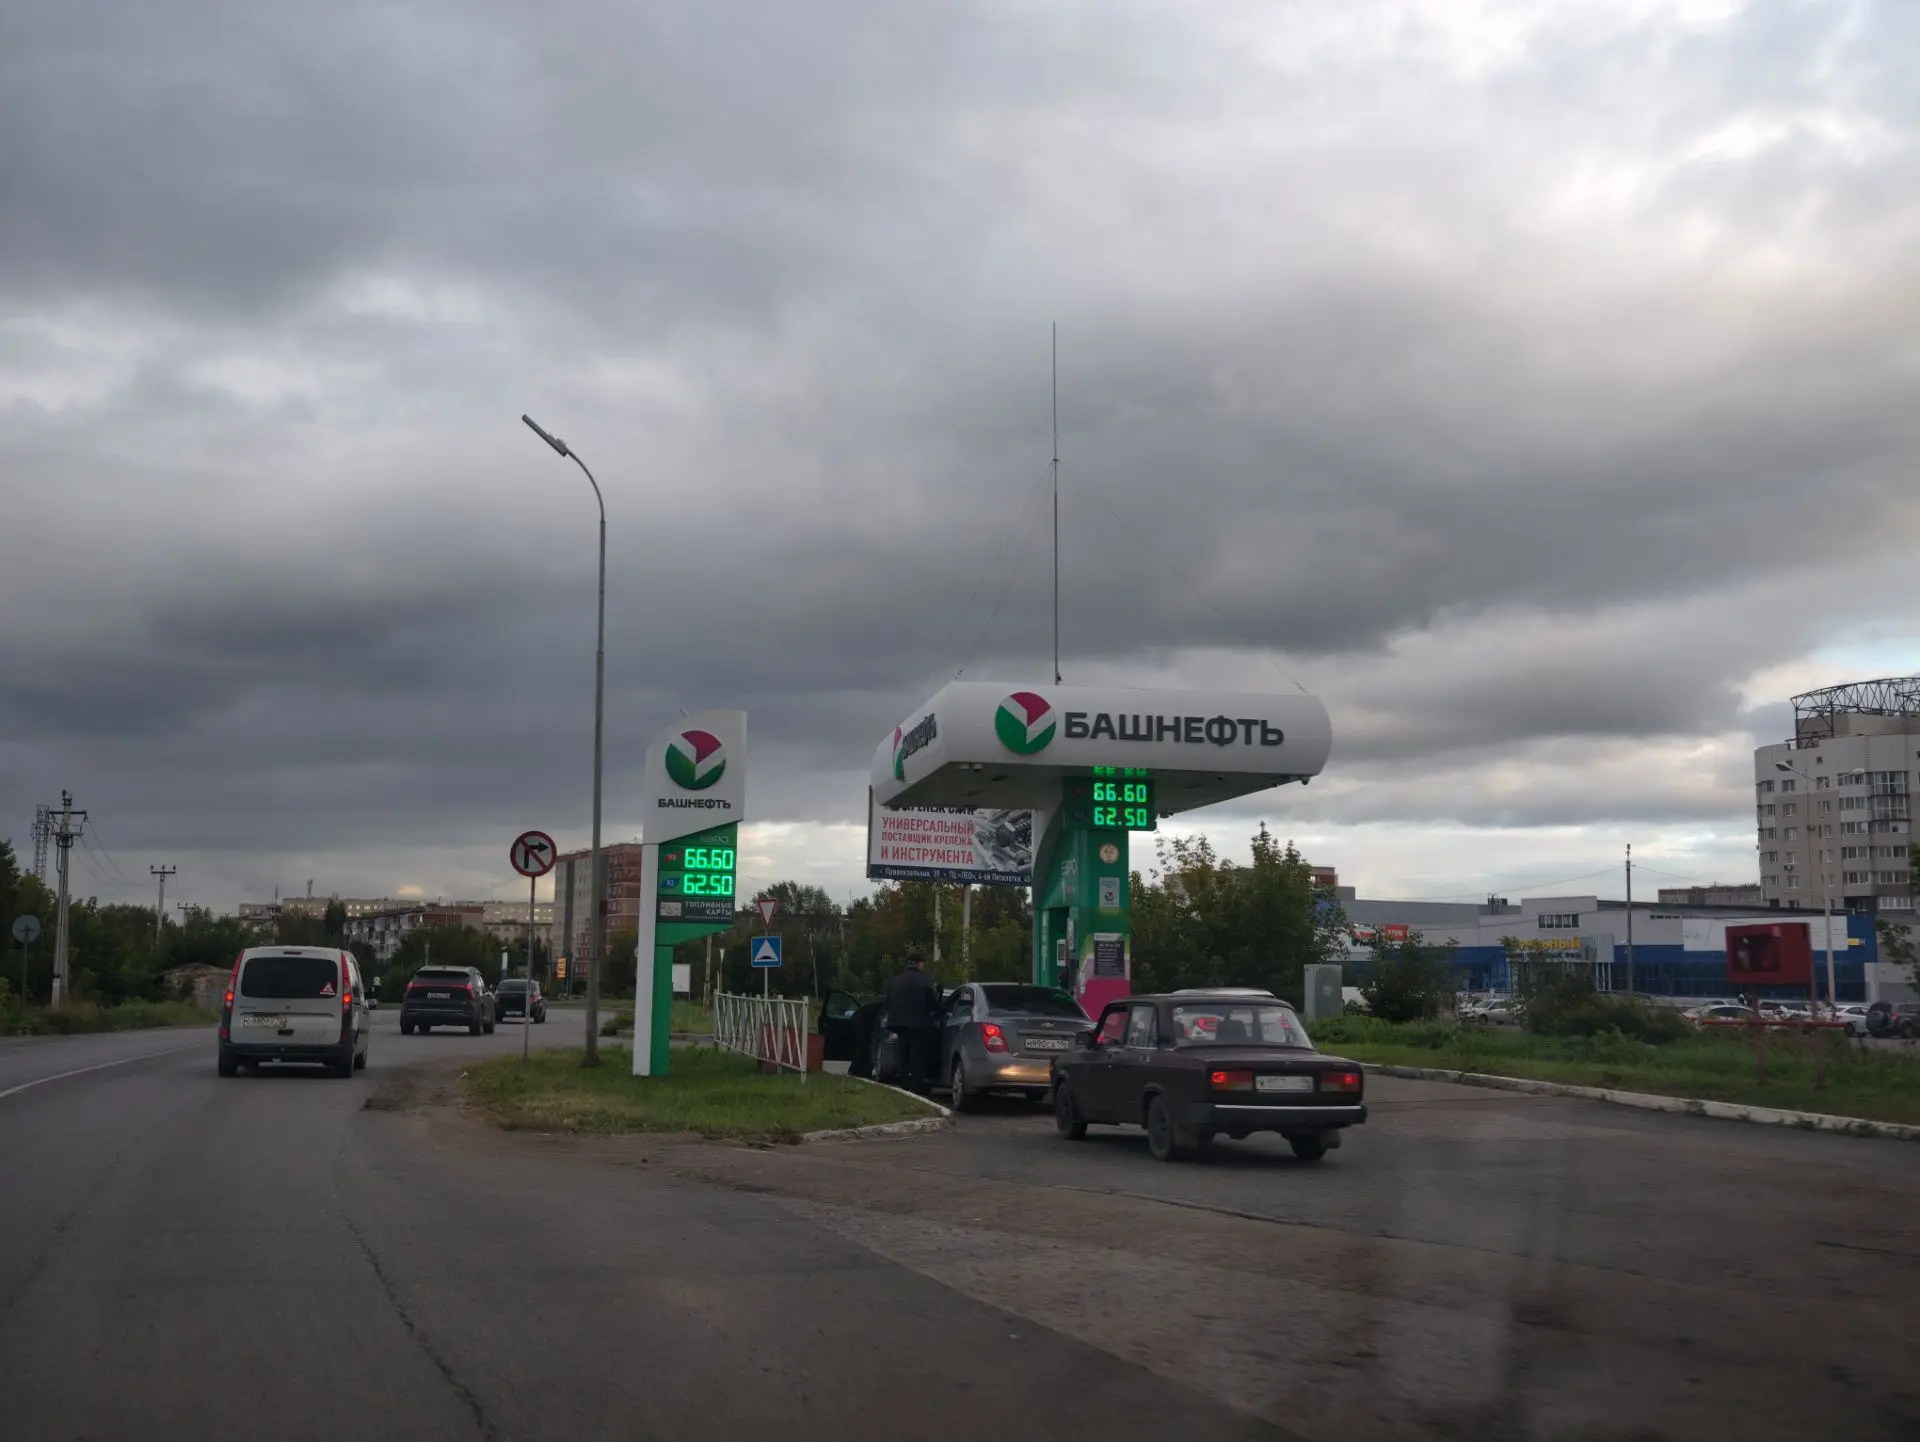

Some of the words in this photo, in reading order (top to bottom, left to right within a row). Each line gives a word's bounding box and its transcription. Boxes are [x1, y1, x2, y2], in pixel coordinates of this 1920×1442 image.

[1064, 711, 1284, 747] БАШНЕФТЬ
[1093, 782, 1147, 803] 66.60
[658, 799, 731, 809] БАШНЕФТЬ
[882, 816, 975, 835] УНИВЕРСАЛЬНЫЙ
[1093, 807, 1147, 827] 62.50
[882, 832, 932, 844] ПОСТАВЩИК
[934, 836, 973, 846] КРЕПЕЖА
[684, 848, 734, 869] 66.60
[881, 846, 888, 860] И
[892, 847, 974, 865] ИНСТРУМЕНТА
[683, 873, 732, 895] 62.50
[685, 901, 732, 909] ТОПЛИВНЫЕ
[706, 908, 732, 916] КАРТЫ
